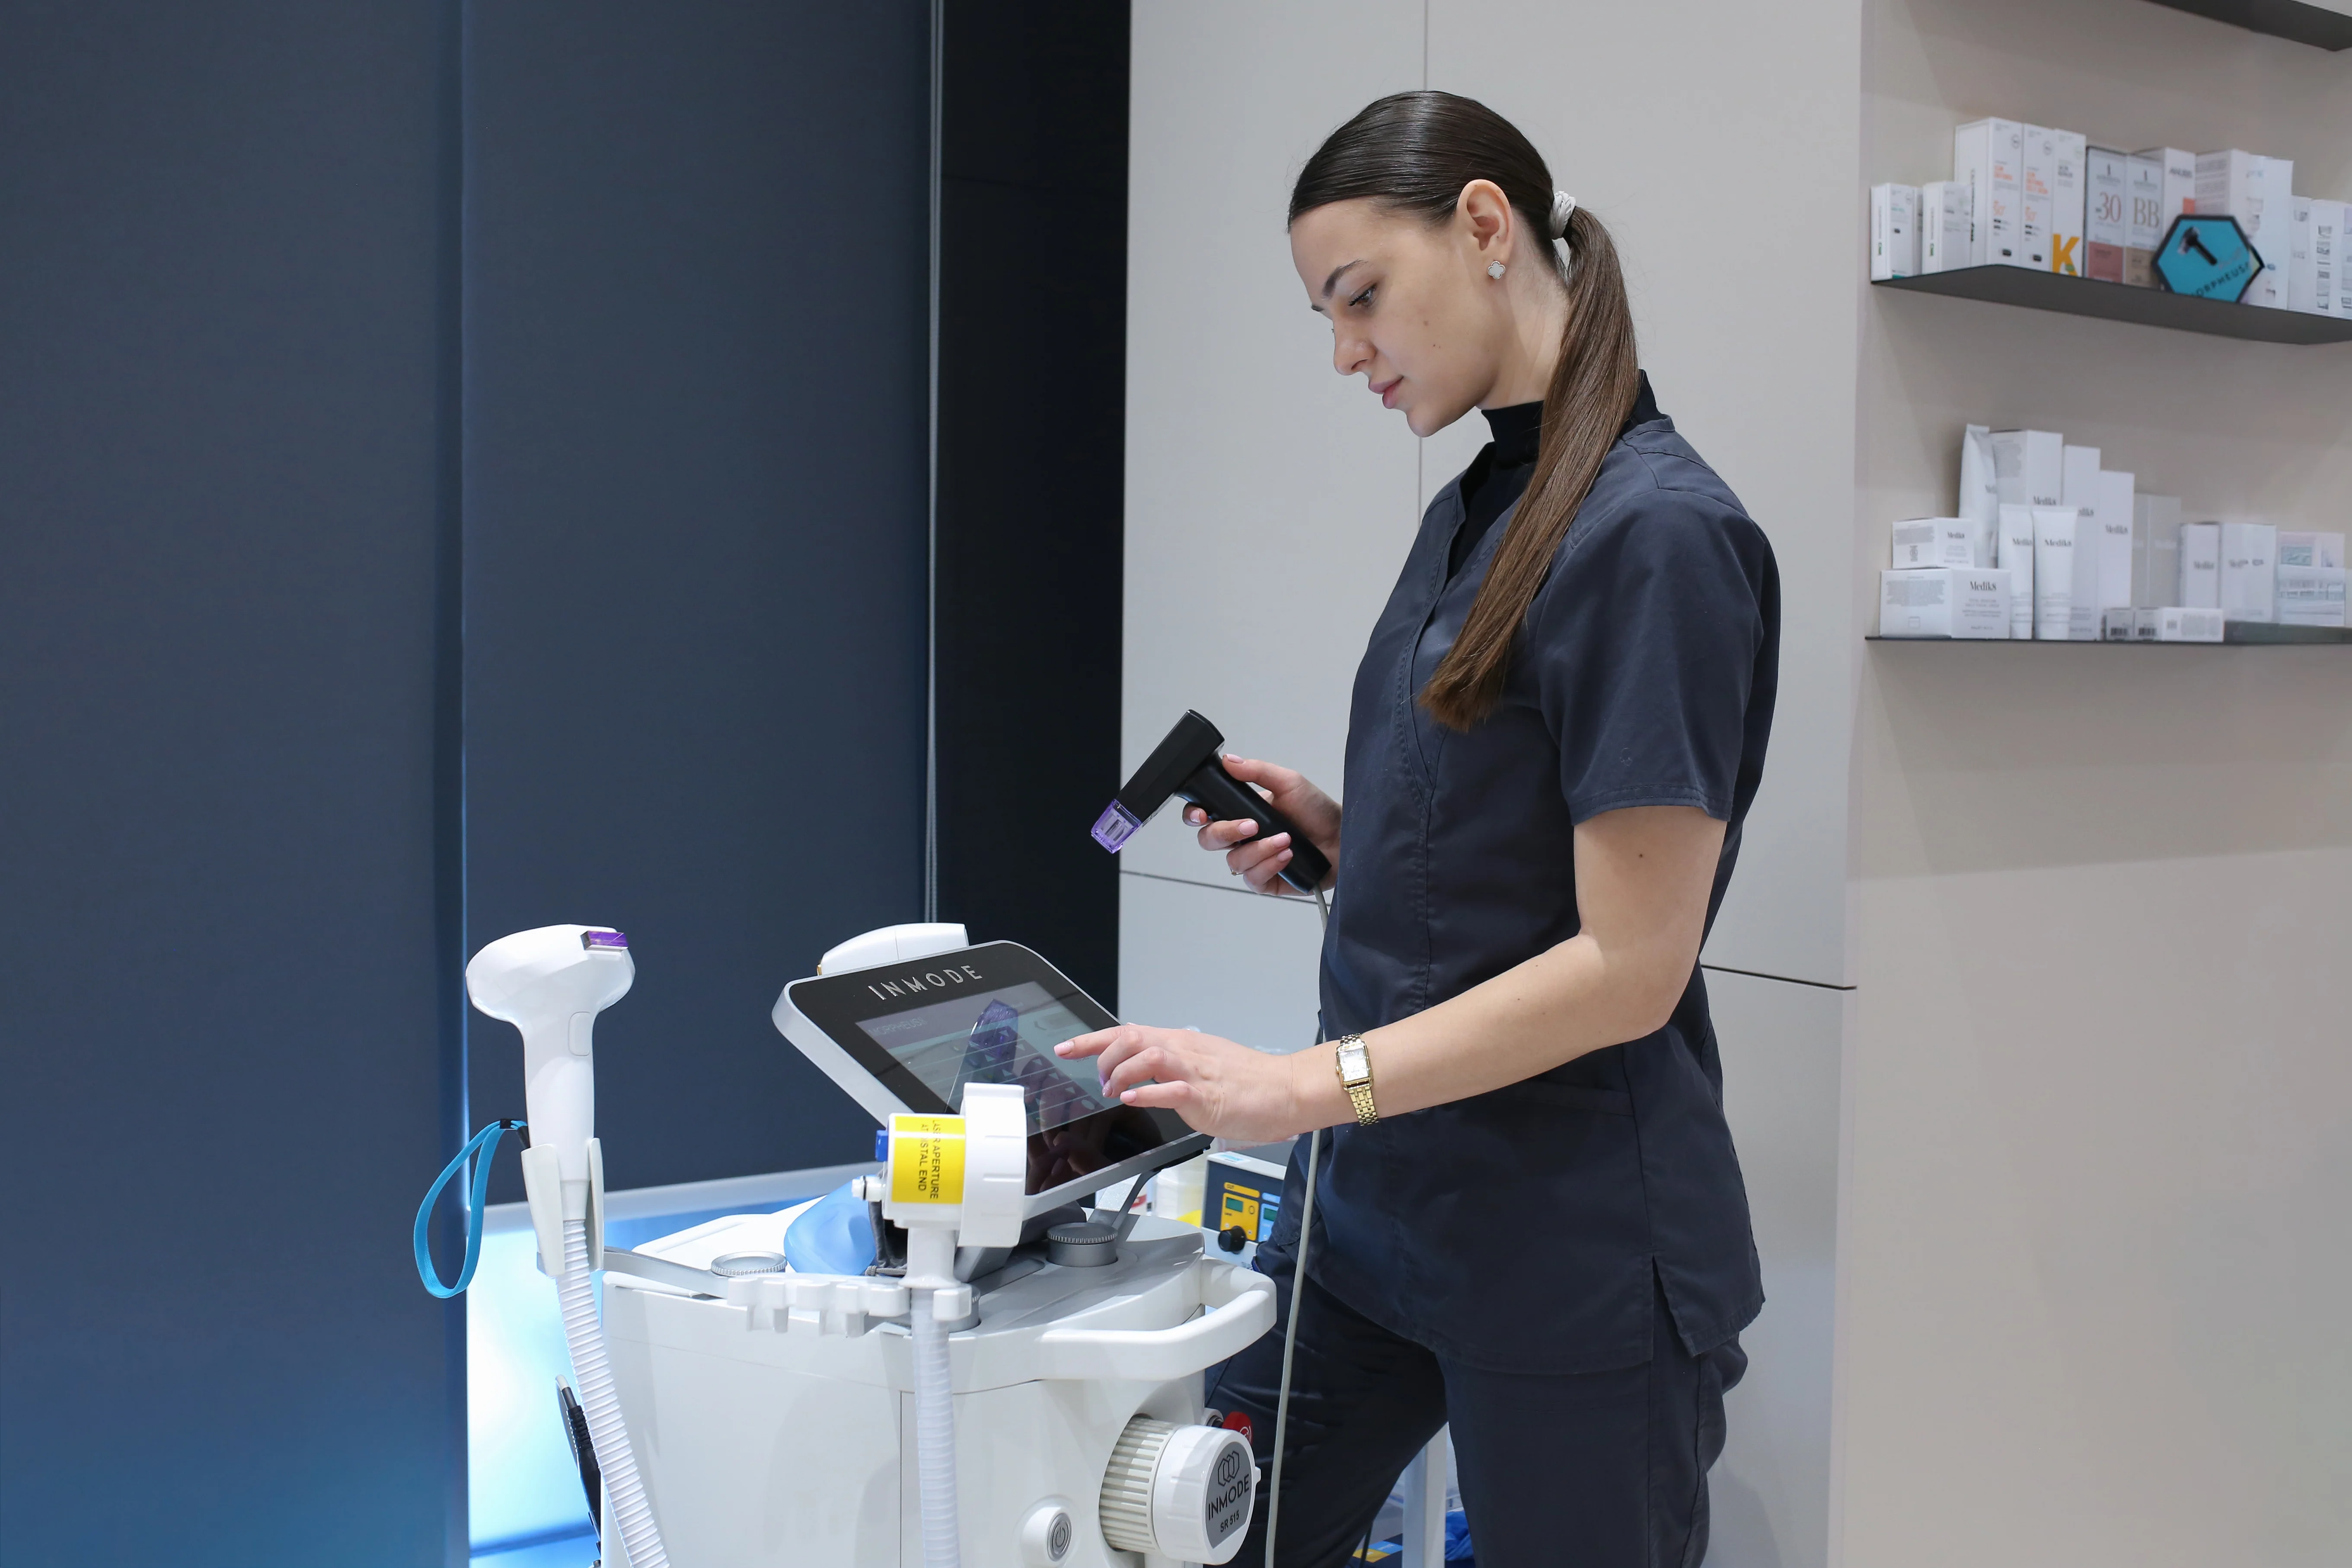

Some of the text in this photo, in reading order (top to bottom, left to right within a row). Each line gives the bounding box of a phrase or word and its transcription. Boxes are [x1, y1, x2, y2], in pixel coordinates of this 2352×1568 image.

[2098, 192, 2121, 223] 30
[2134, 197, 2160, 229] BB
[2052, 233, 2080, 276] K
[1970, 581, 1997, 591] Medik8
[868, 965, 983, 1000] INMODE
[918, 1170, 927, 1191] END
[930, 1145, 941, 1199] APERTURE
[1208, 1473, 1250, 1521] INMODE
[1220, 1510, 1240, 1533] SR 515
